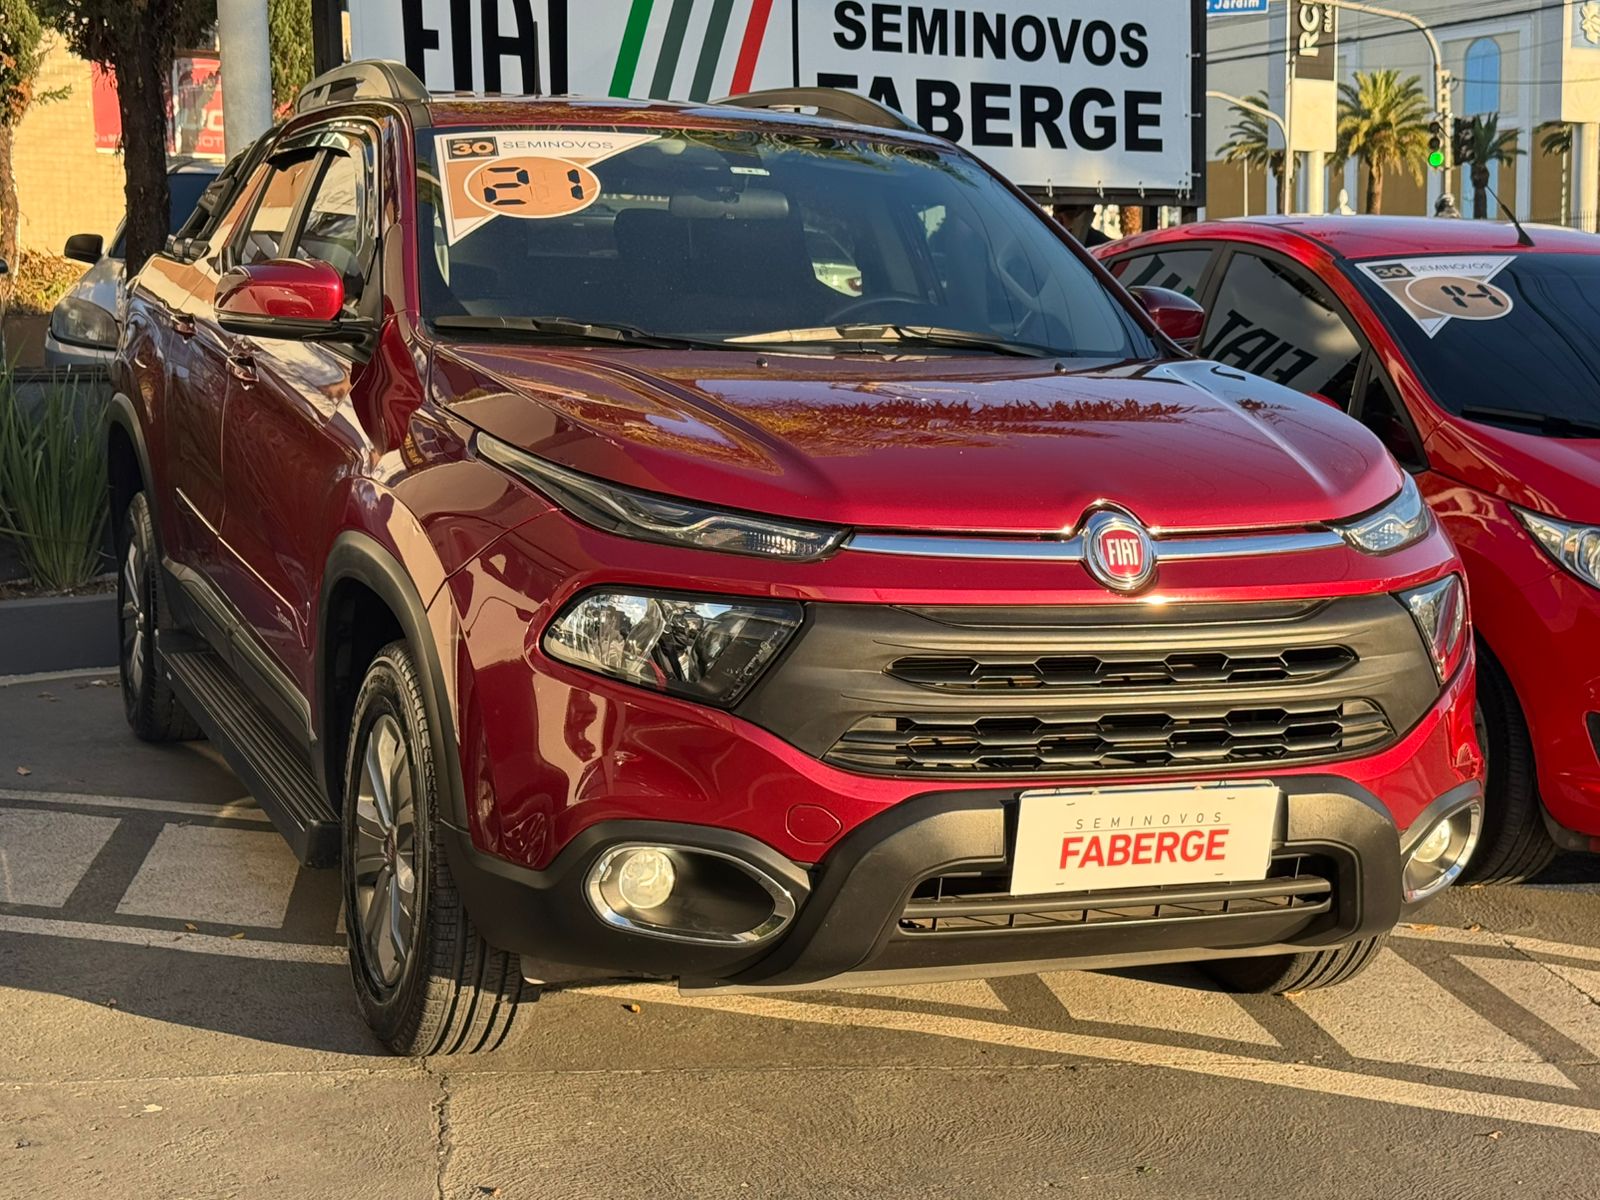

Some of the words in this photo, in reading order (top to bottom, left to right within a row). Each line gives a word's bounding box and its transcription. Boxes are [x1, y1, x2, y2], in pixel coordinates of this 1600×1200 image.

[833, 0, 1149, 68] SEMINOVOS
[452, 141, 494, 156] 30
[502, 140, 614, 150] SEMINOVOS
[1375, 266, 1408, 278] 30
[1410, 262, 1494, 273] SEMINOVOS
[1105, 538, 1140, 566] FIAT
[1075, 812, 1222, 830] SEMINOVOS
[1059, 829, 1230, 870] FABERGE
